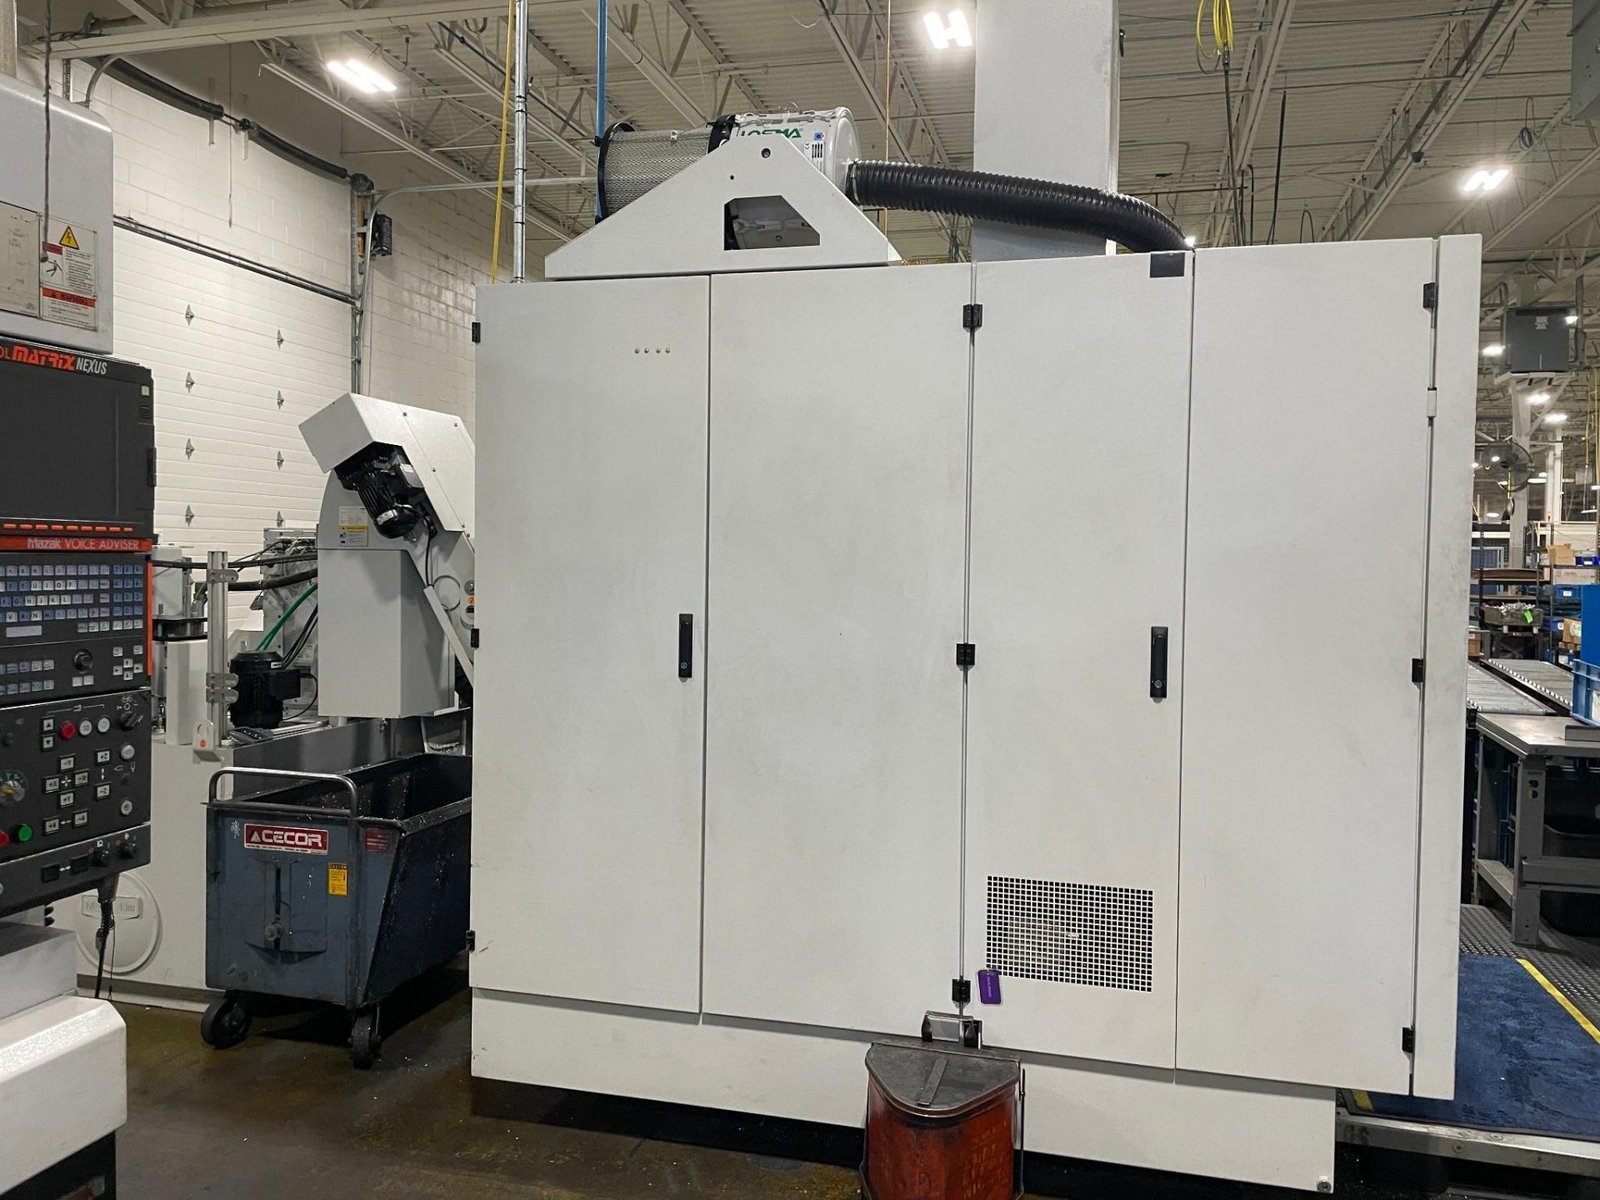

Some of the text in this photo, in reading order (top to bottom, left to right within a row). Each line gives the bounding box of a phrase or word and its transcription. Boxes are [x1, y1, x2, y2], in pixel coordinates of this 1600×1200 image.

[12, 345, 75, 371] MATRIX
[76, 357, 107, 375] NEXUS
[65, 539, 95, 550] VOICE
[100, 540, 139, 550] ADVISER
[262, 829, 322, 847] CECOR
